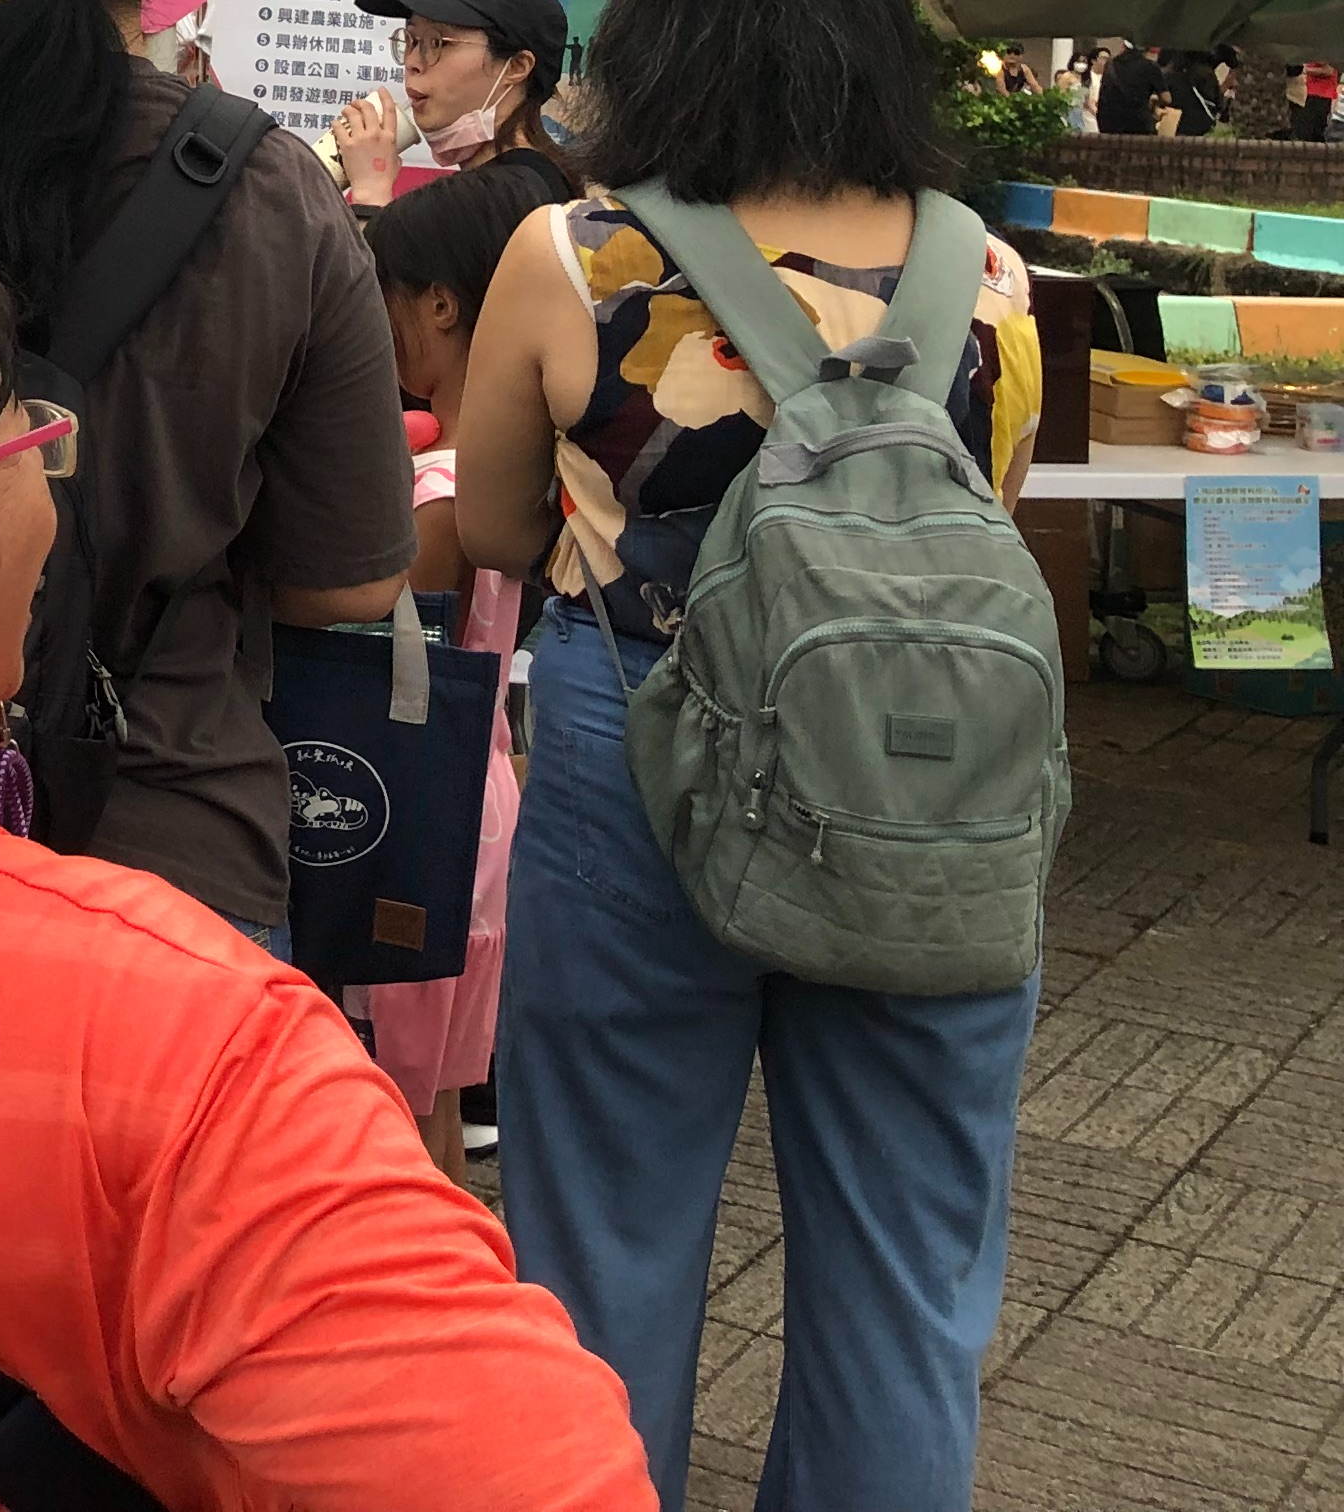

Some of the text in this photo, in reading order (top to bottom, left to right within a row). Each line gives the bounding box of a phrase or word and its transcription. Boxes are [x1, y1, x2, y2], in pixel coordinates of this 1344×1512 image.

[277, 7, 387, 30] 興建農業設施。
[275, 33, 385, 56] 興辦休閒農場。
[271, 110, 343, 130] 設置殯葬
